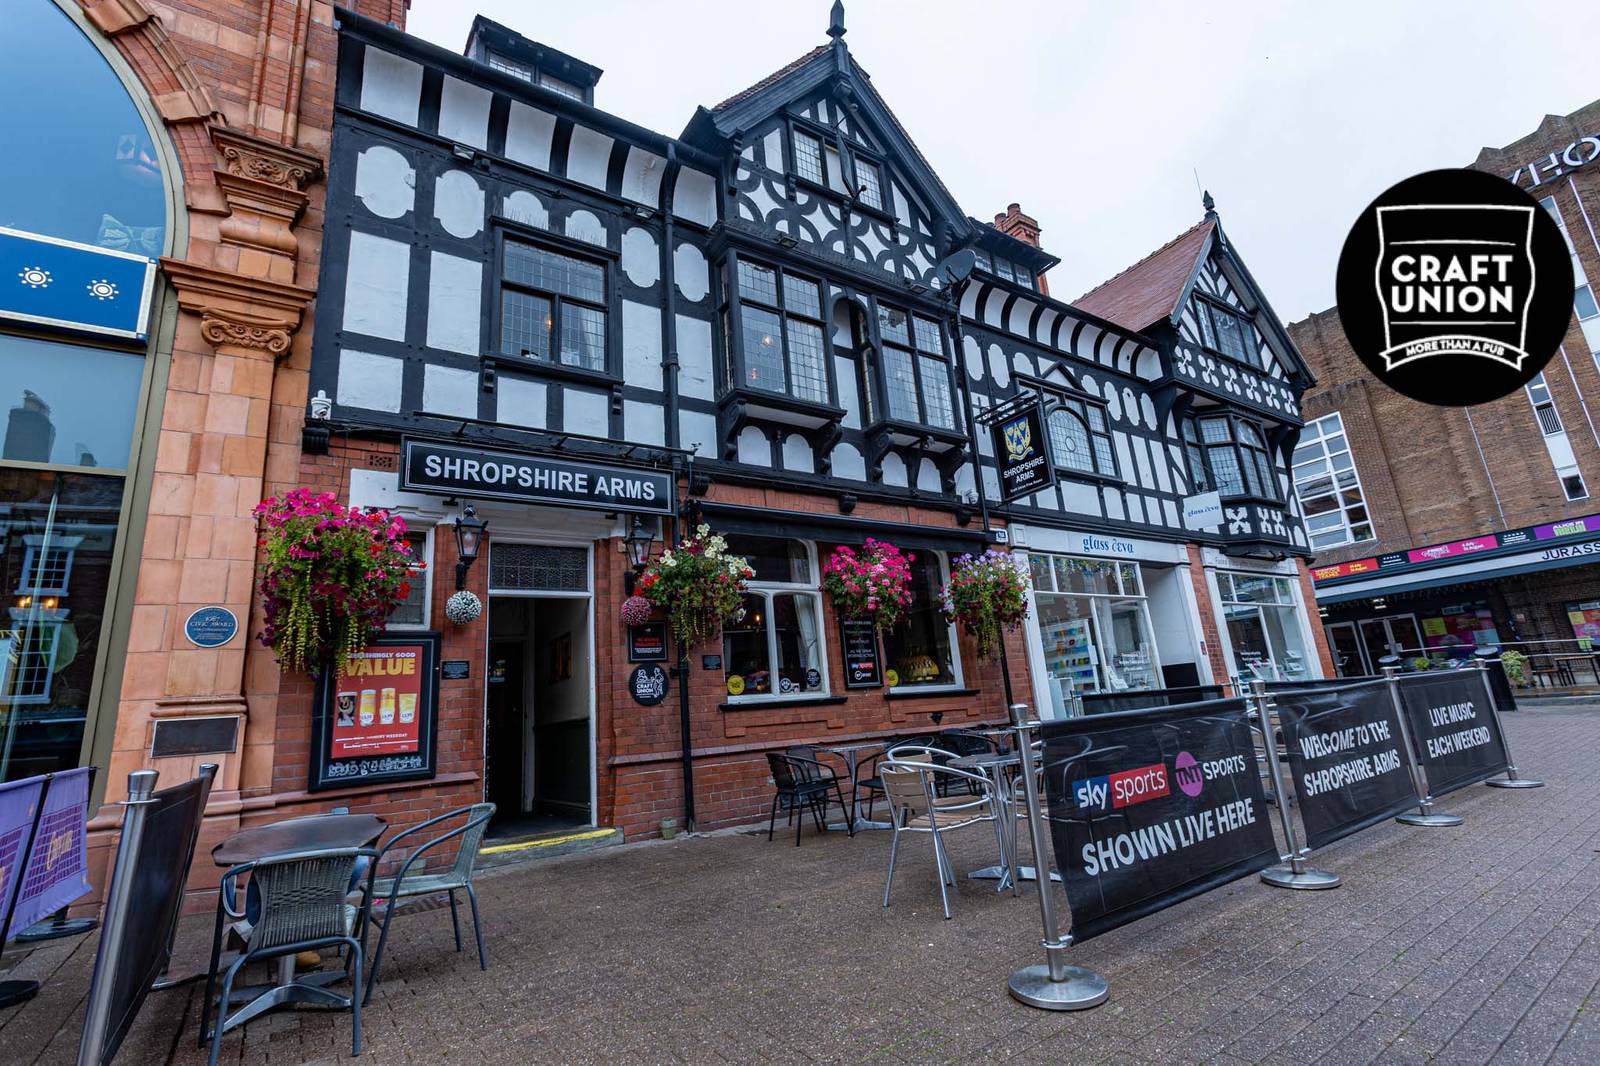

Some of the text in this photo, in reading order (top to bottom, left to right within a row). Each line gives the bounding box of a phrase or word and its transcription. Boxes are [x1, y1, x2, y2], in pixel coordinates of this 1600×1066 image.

[425, 455, 656, 501] SHROPSHIRE ARMS
[1003, 456, 1045, 479] SHROPSHIRE
[1015, 470, 1035, 484] ARMS
[1082, 535, 1110, 553] glass
[345, 657, 416, 677] VALUE
[1429, 701, 1476, 727] LIVE MUSIC
[1300, 720, 1391, 760] WELCOME TO THE
[1426, 727, 1491, 758] EACH WEEKEND
[1077, 754, 1246, 810] sky sports TNT SPORTS
[1303, 749, 1401, 797] SHROPSHIRE ARMS
[1082, 798, 1256, 877] SHOWN LIVE HERE
